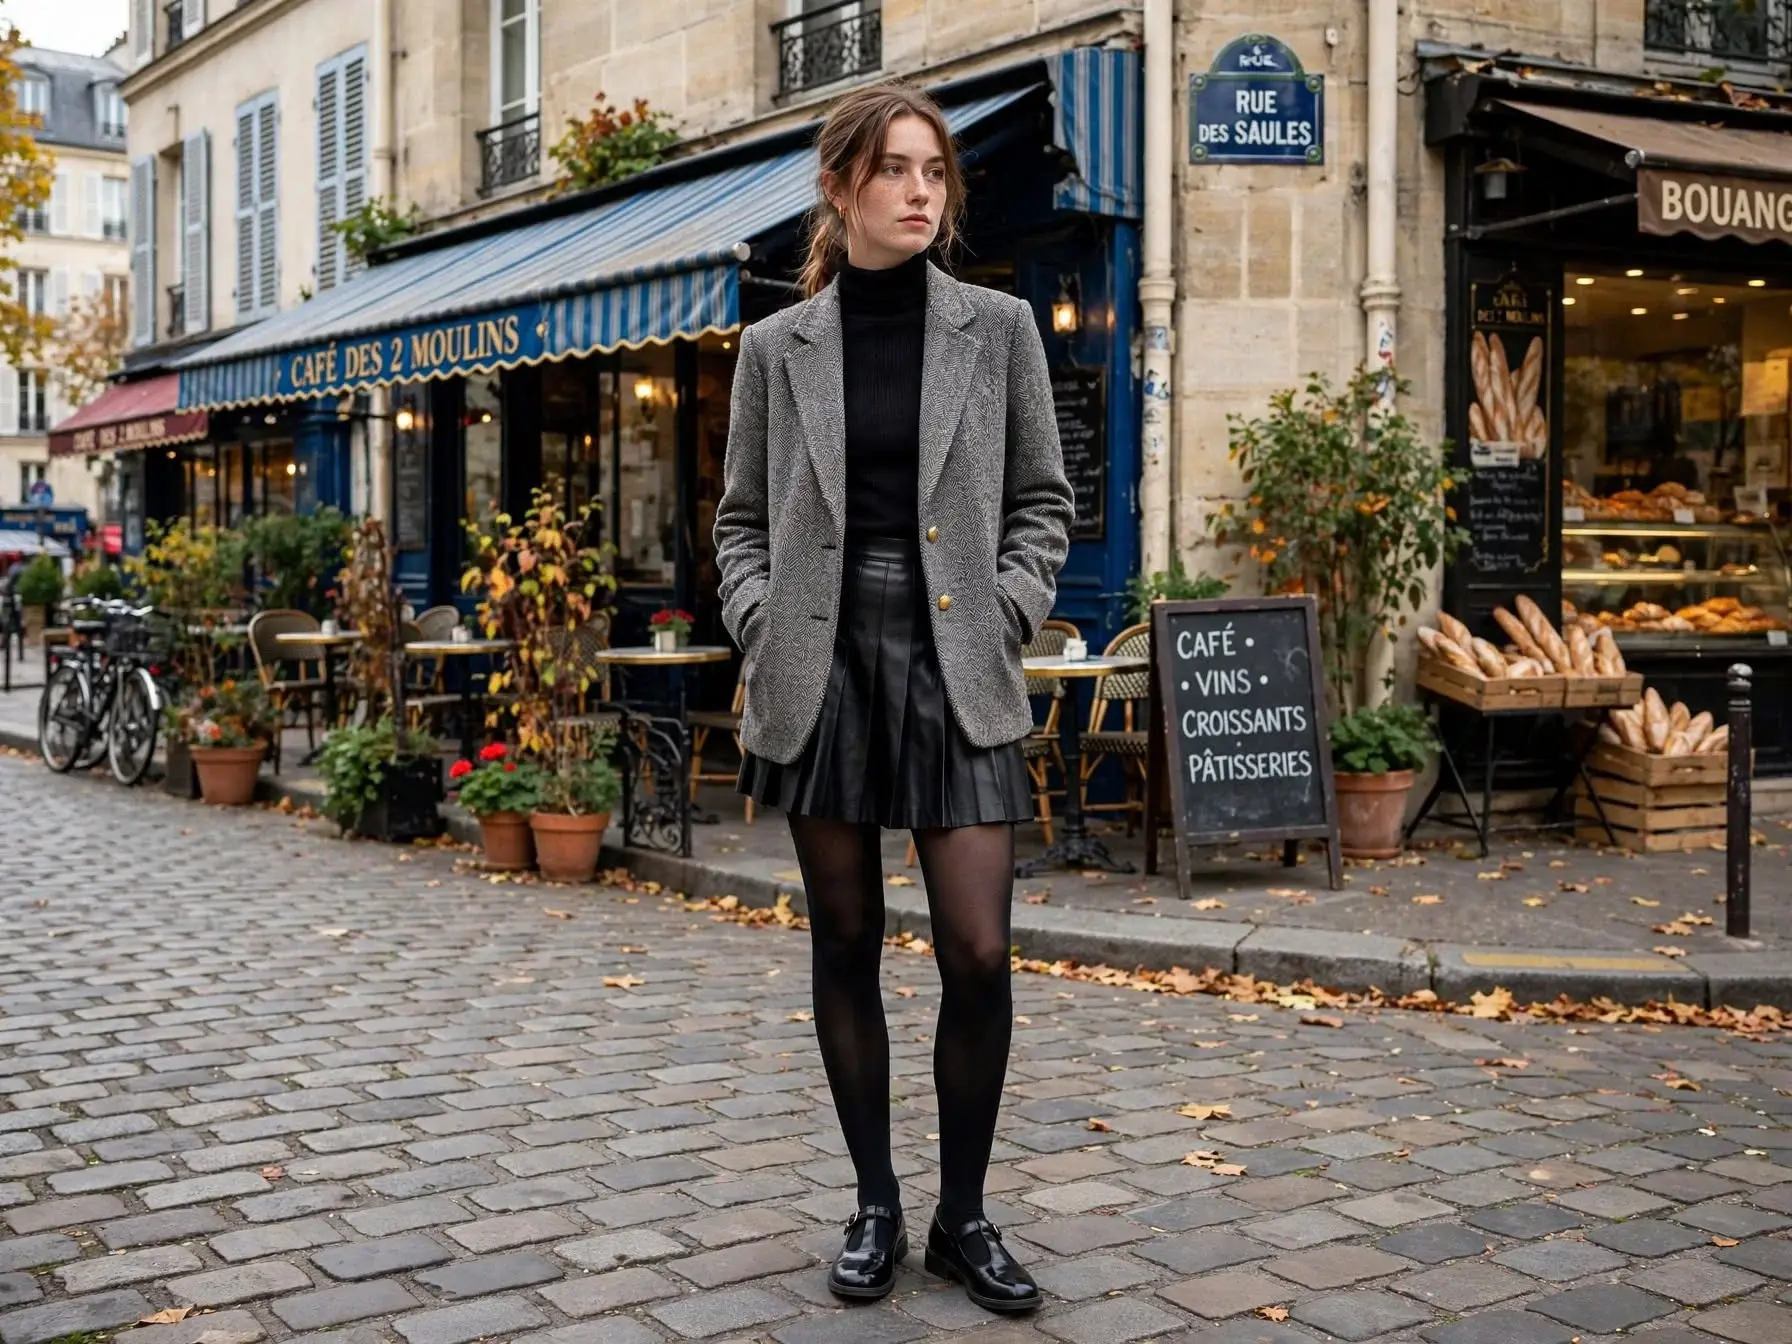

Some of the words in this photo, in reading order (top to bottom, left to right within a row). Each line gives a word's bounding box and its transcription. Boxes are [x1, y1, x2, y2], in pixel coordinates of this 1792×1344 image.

[1236, 90, 1277, 114] RUE
[1199, 124, 1229, 142] DES
[1234, 120, 1312, 145] SAULES
[1661, 180, 1792, 232] BOUANG
[291, 341, 338, 388] CAFÉ
[345, 341, 383, 379] DES
[390, 337, 403, 372] 2
[411, 315, 520, 369] MOULINS
[1176, 622, 1236, 660] CAFÉ
[1195, 668, 1252, 697] VINS
[1182, 705, 1307, 738] CROISSANTS
[1189, 748, 1312, 783] PÂTISSERIES
